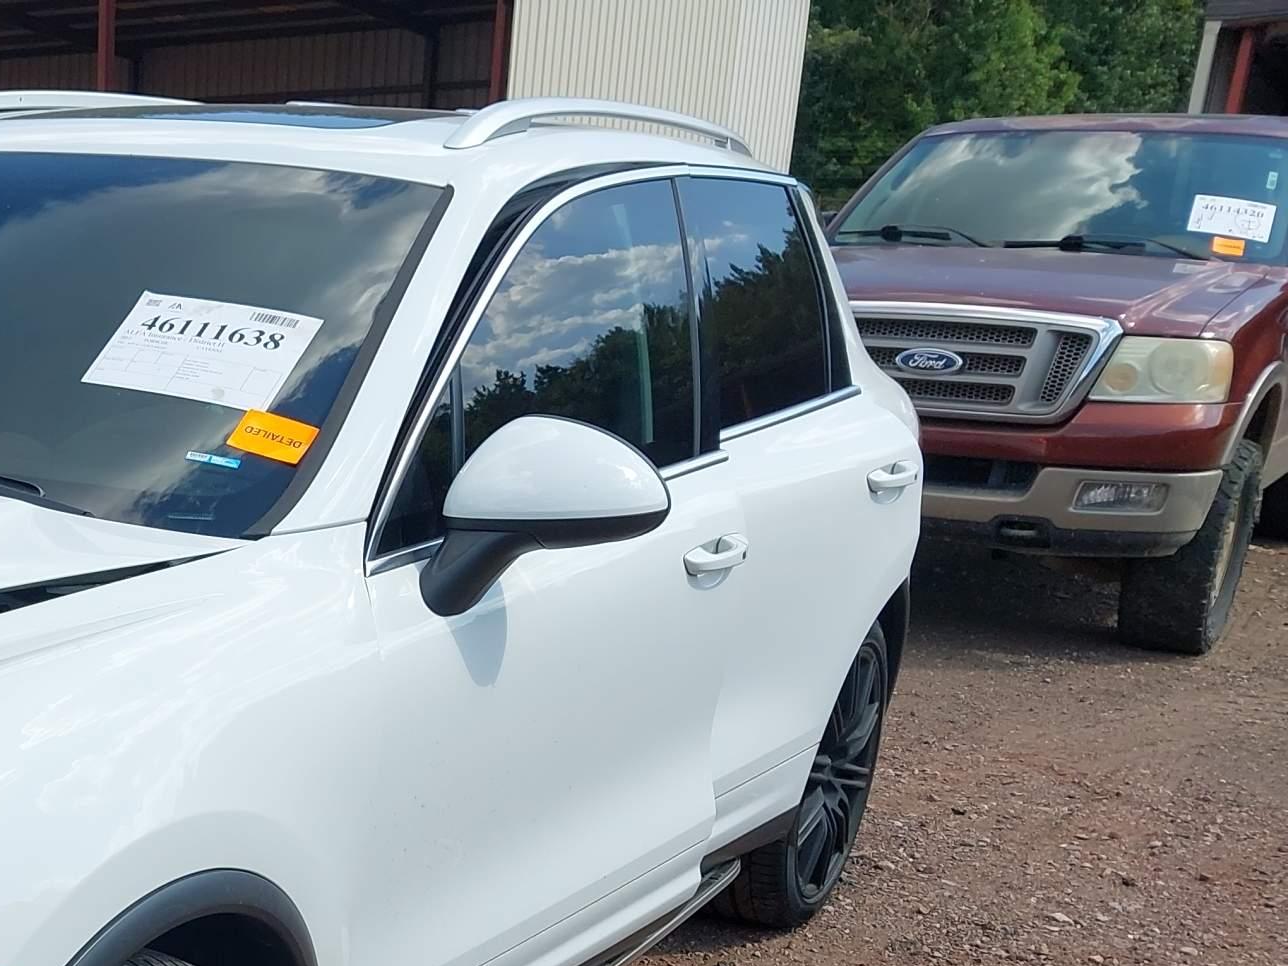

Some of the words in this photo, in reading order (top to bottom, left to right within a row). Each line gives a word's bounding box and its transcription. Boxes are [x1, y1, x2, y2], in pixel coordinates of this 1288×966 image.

[141, 315, 285, 350] 46111638
[909, 352, 947, 369] Ford
[244, 425, 303, 449] DETAILED
